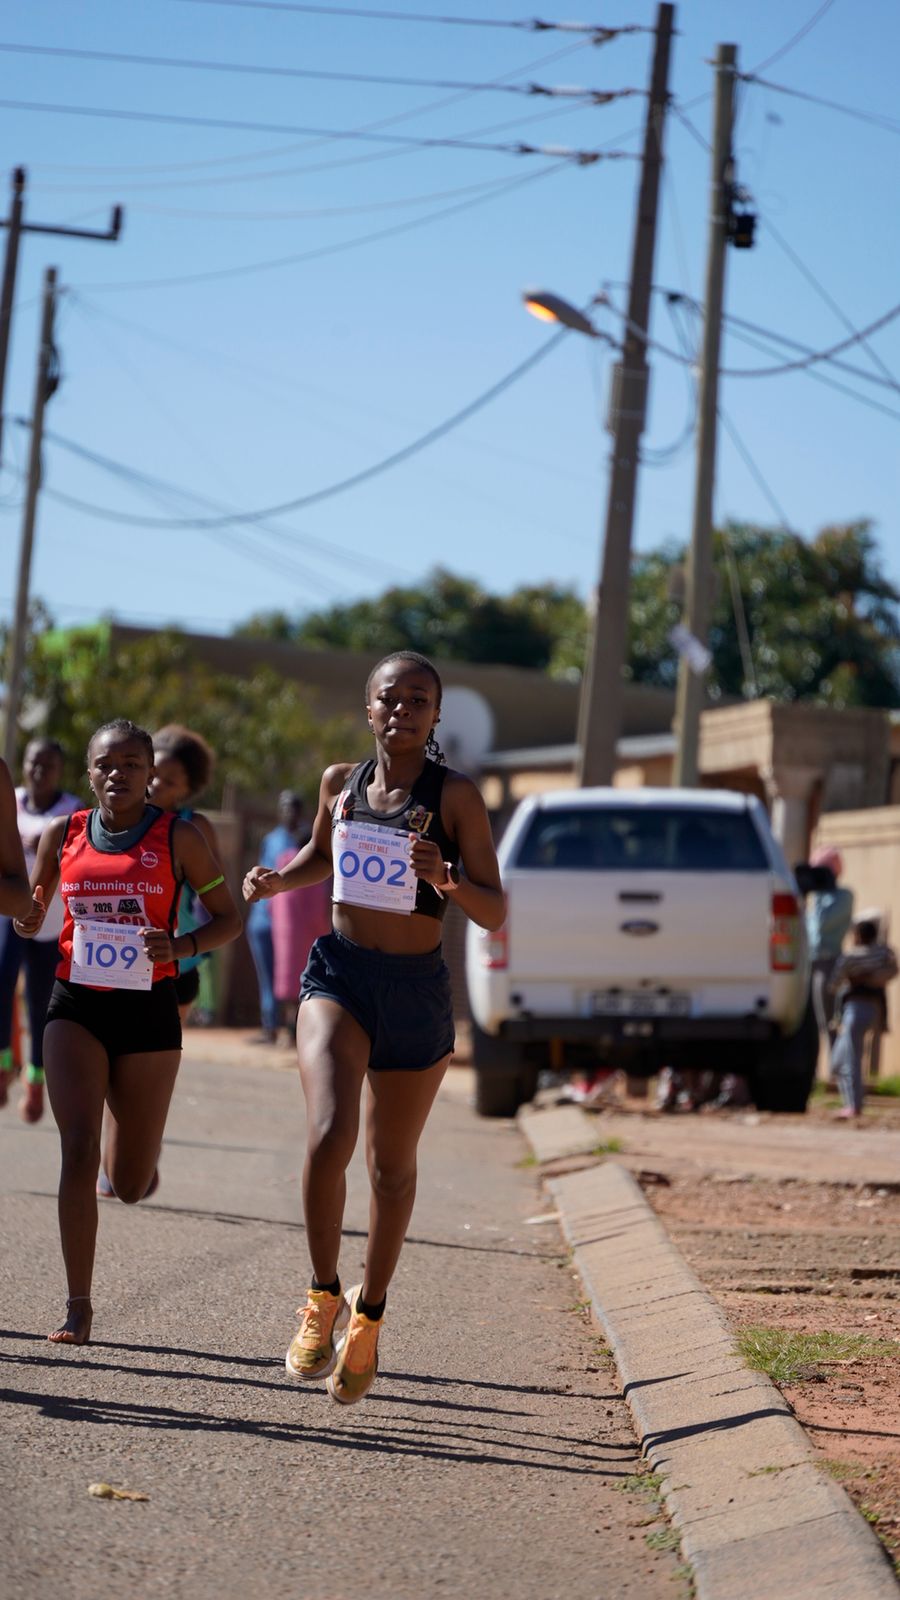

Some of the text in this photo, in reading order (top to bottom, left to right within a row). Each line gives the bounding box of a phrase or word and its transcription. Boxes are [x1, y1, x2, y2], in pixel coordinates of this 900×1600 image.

[359, 842, 376, 851] STREET
[339, 851, 407, 887] 002
[83, 880, 134, 894] Running
[137, 881, 164, 894] Club
[93, 902, 113, 913] 2026
[85, 942, 138, 969] 109
